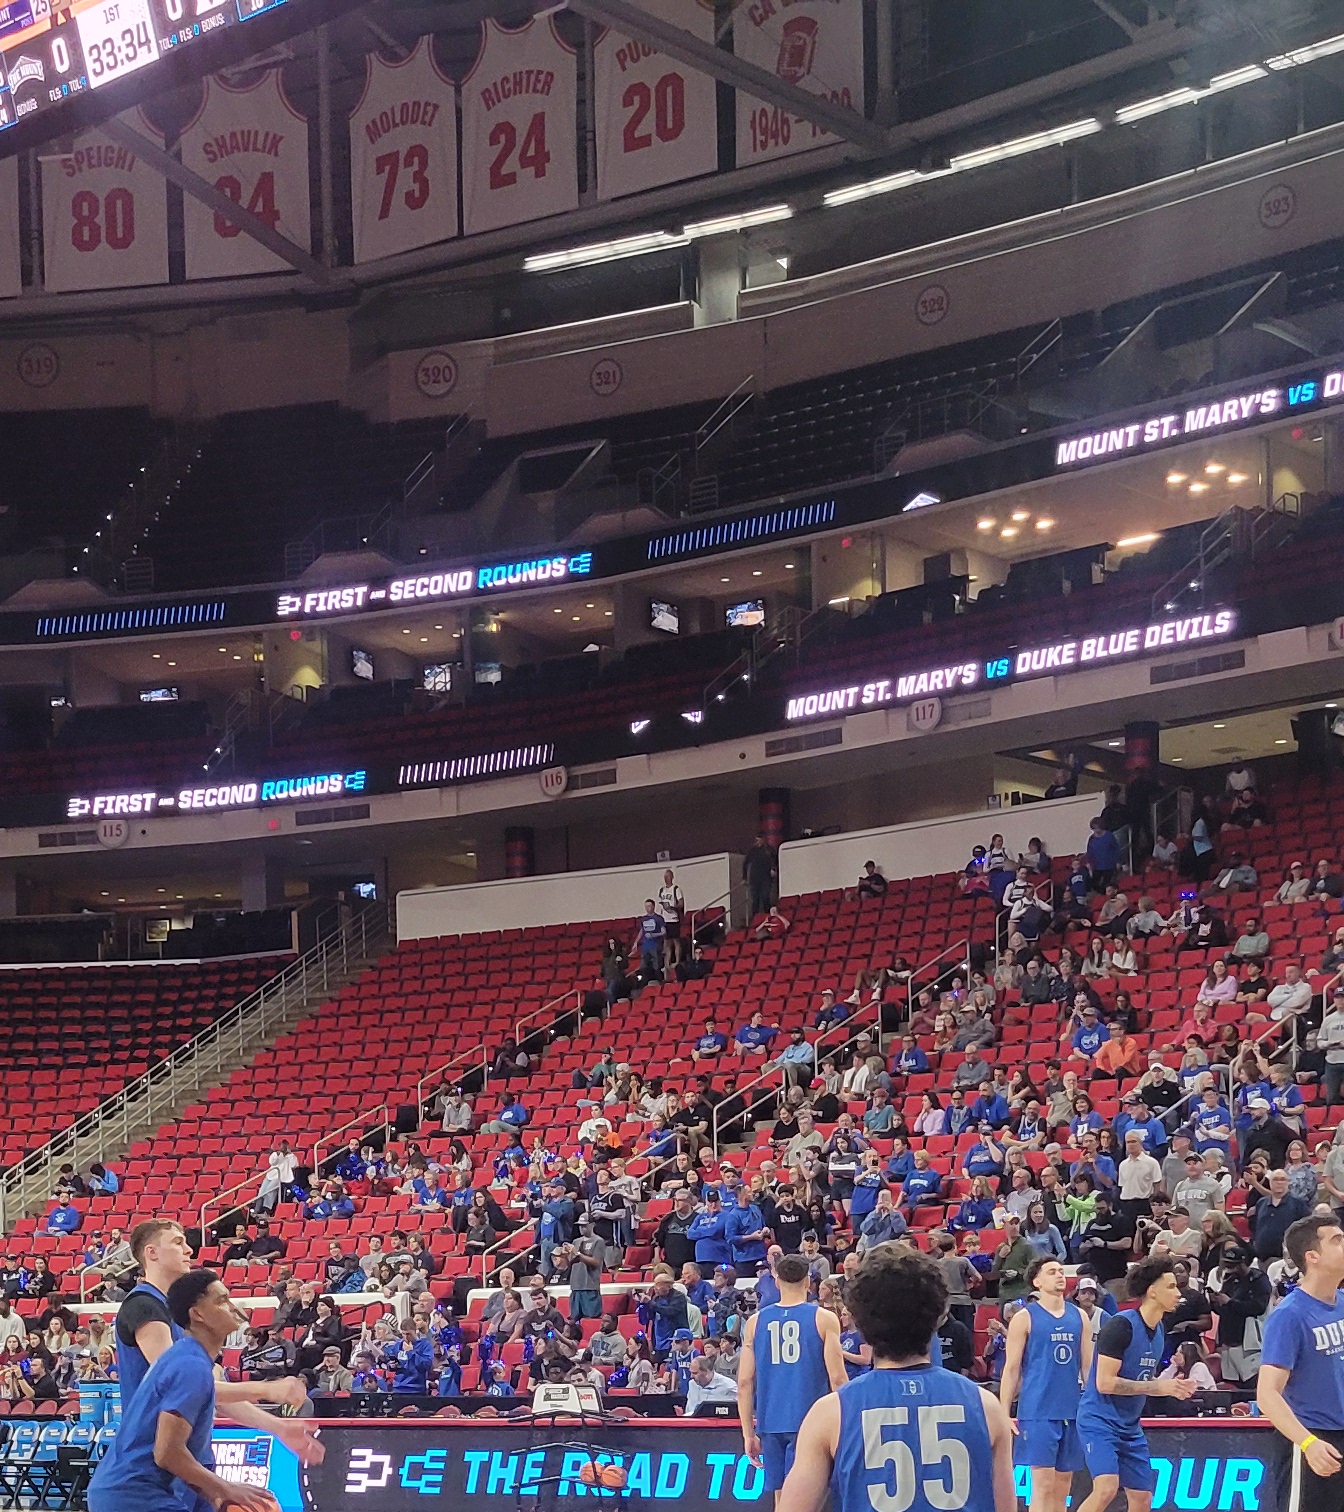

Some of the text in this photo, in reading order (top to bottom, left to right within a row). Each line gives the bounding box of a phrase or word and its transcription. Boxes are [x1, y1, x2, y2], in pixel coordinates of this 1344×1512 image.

[103, 4, 120, 24] 1ST
[51, 37, 70, 74] 0
[88, 21, 152, 78] 33:34
[480, 70, 554, 111] RICHTER
[365, 100, 440, 145] MOLODET
[622, 71, 685, 154] 20
[203, 129, 285, 164] SHAVLIK
[489, 111, 551, 191] 24
[376, 143, 430, 221] 73
[71, 187, 136, 252] 80
[24, 357, 54, 374] 319
[420, 366, 453, 384] 320
[595, 367, 618, 387] 321
[1058, 429, 1137, 465] MOUNT
[1144, 418, 1178, 444] ST.
[1184, 389, 1278, 434] MARY'S
[1288, 382, 1316, 405] VS
[304, 586, 368, 613] FIRST
[390, 570, 473, 600] SECOND
[477, 557, 567, 589] ROUNDS
[786, 611, 1232, 720] MOUNT ST. MARY'S VS DUKE BLUE DEVILS
[914, 703, 935, 722] 117
[92, 792, 156, 815] FIRST
[178, 783, 258, 809] SECOND
[260, 774, 343, 801] ROUNDS
[543, 771, 563, 787] 116
[102, 823, 122, 838] 115
[767, 1320, 800, 1364] 18
[463, 1451, 546, 1495] THE
[706, 1453, 765, 1500] TO
[1150, 1458, 1265, 1512] OUR
